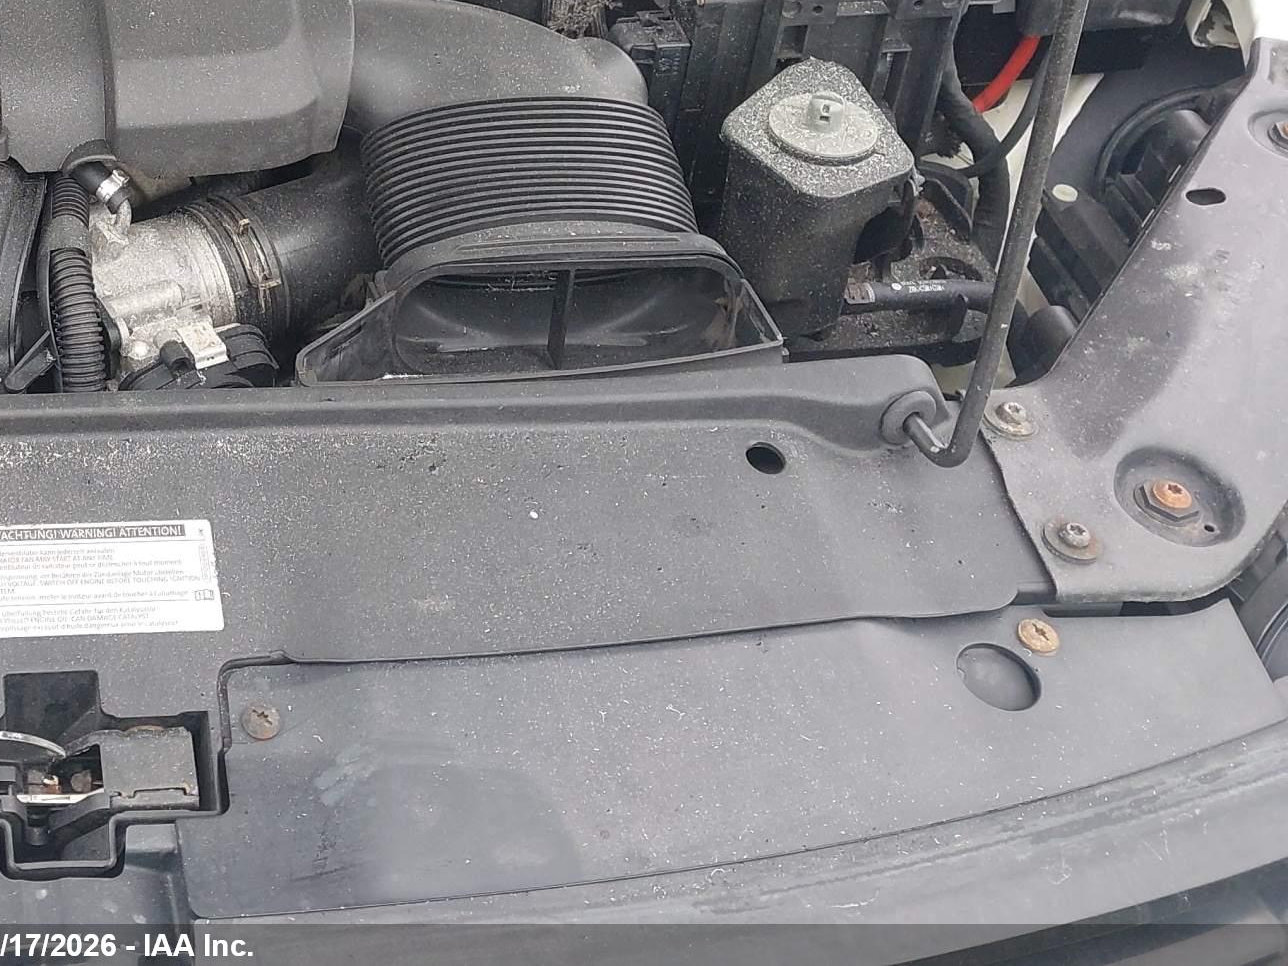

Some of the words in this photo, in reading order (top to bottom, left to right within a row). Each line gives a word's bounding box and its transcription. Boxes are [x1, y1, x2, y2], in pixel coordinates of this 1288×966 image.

[0, 529, 57, 541] ACHTUNG!
[60, 527, 116, 539] WARNING!
[119, 525, 182, 537] ATTENTION!
